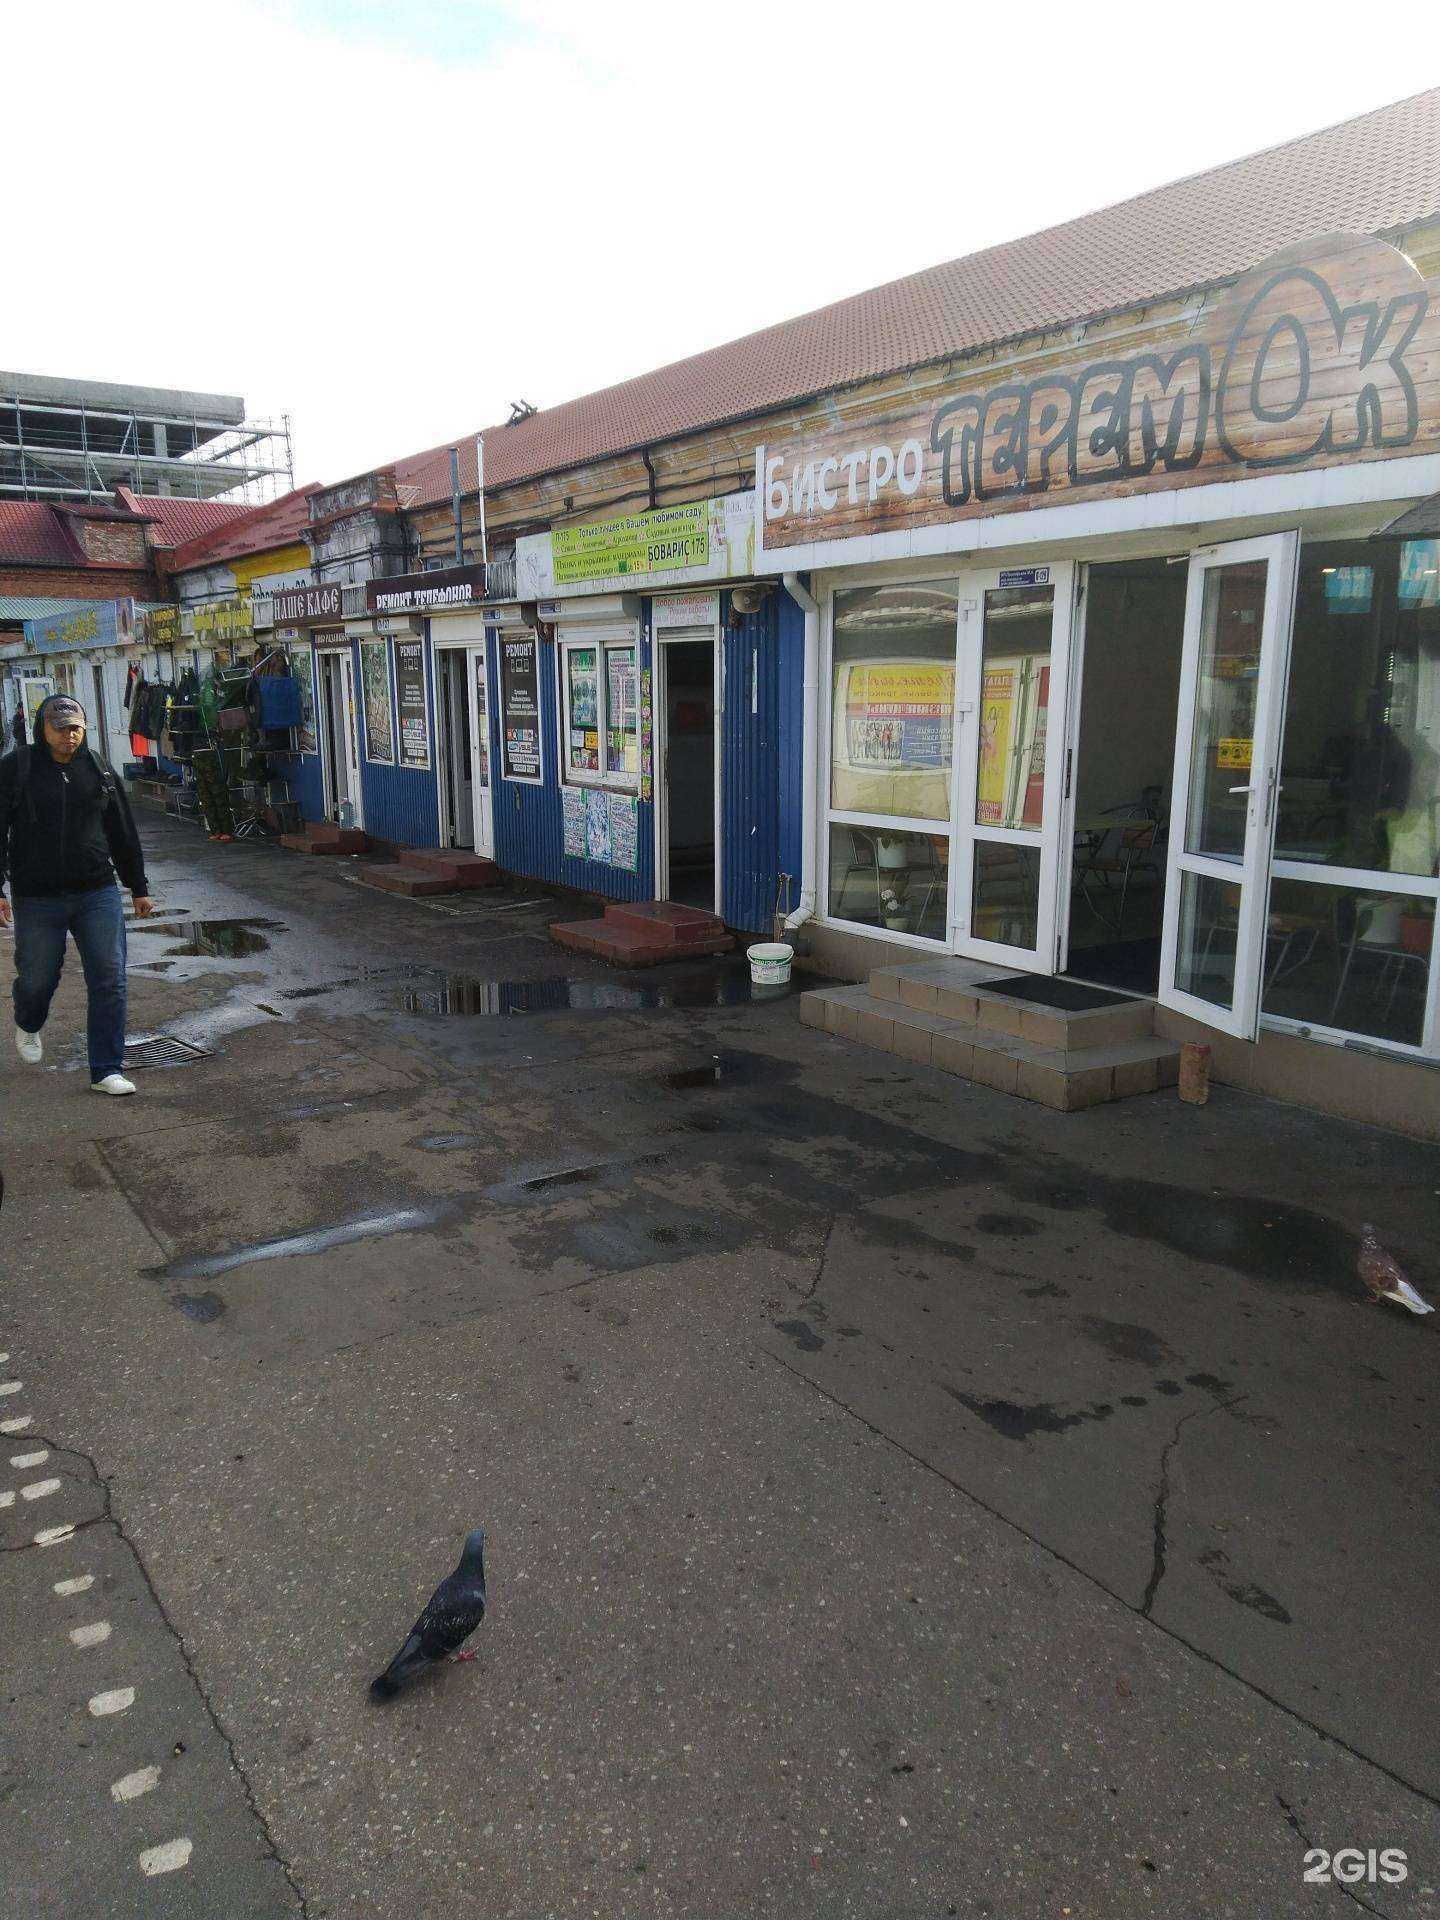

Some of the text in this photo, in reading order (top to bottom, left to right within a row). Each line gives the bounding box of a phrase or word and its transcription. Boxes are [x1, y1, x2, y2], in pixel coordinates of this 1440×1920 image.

[764, 266, 1430, 520] БИСТРО ТЕРЕМОК
[652, 511, 684, 525] любимом
[647, 539, 690, 562] БОВАРИС
[691, 537, 705, 555] 175
[274, 595, 304, 620] НАШЕ
[307, 588, 339, 616] КАФЕ
[376, 584, 473, 610] РЕМОНТ ТЕЛЕФОНОВ
[505, 643, 532, 658] РЕМОНТ
